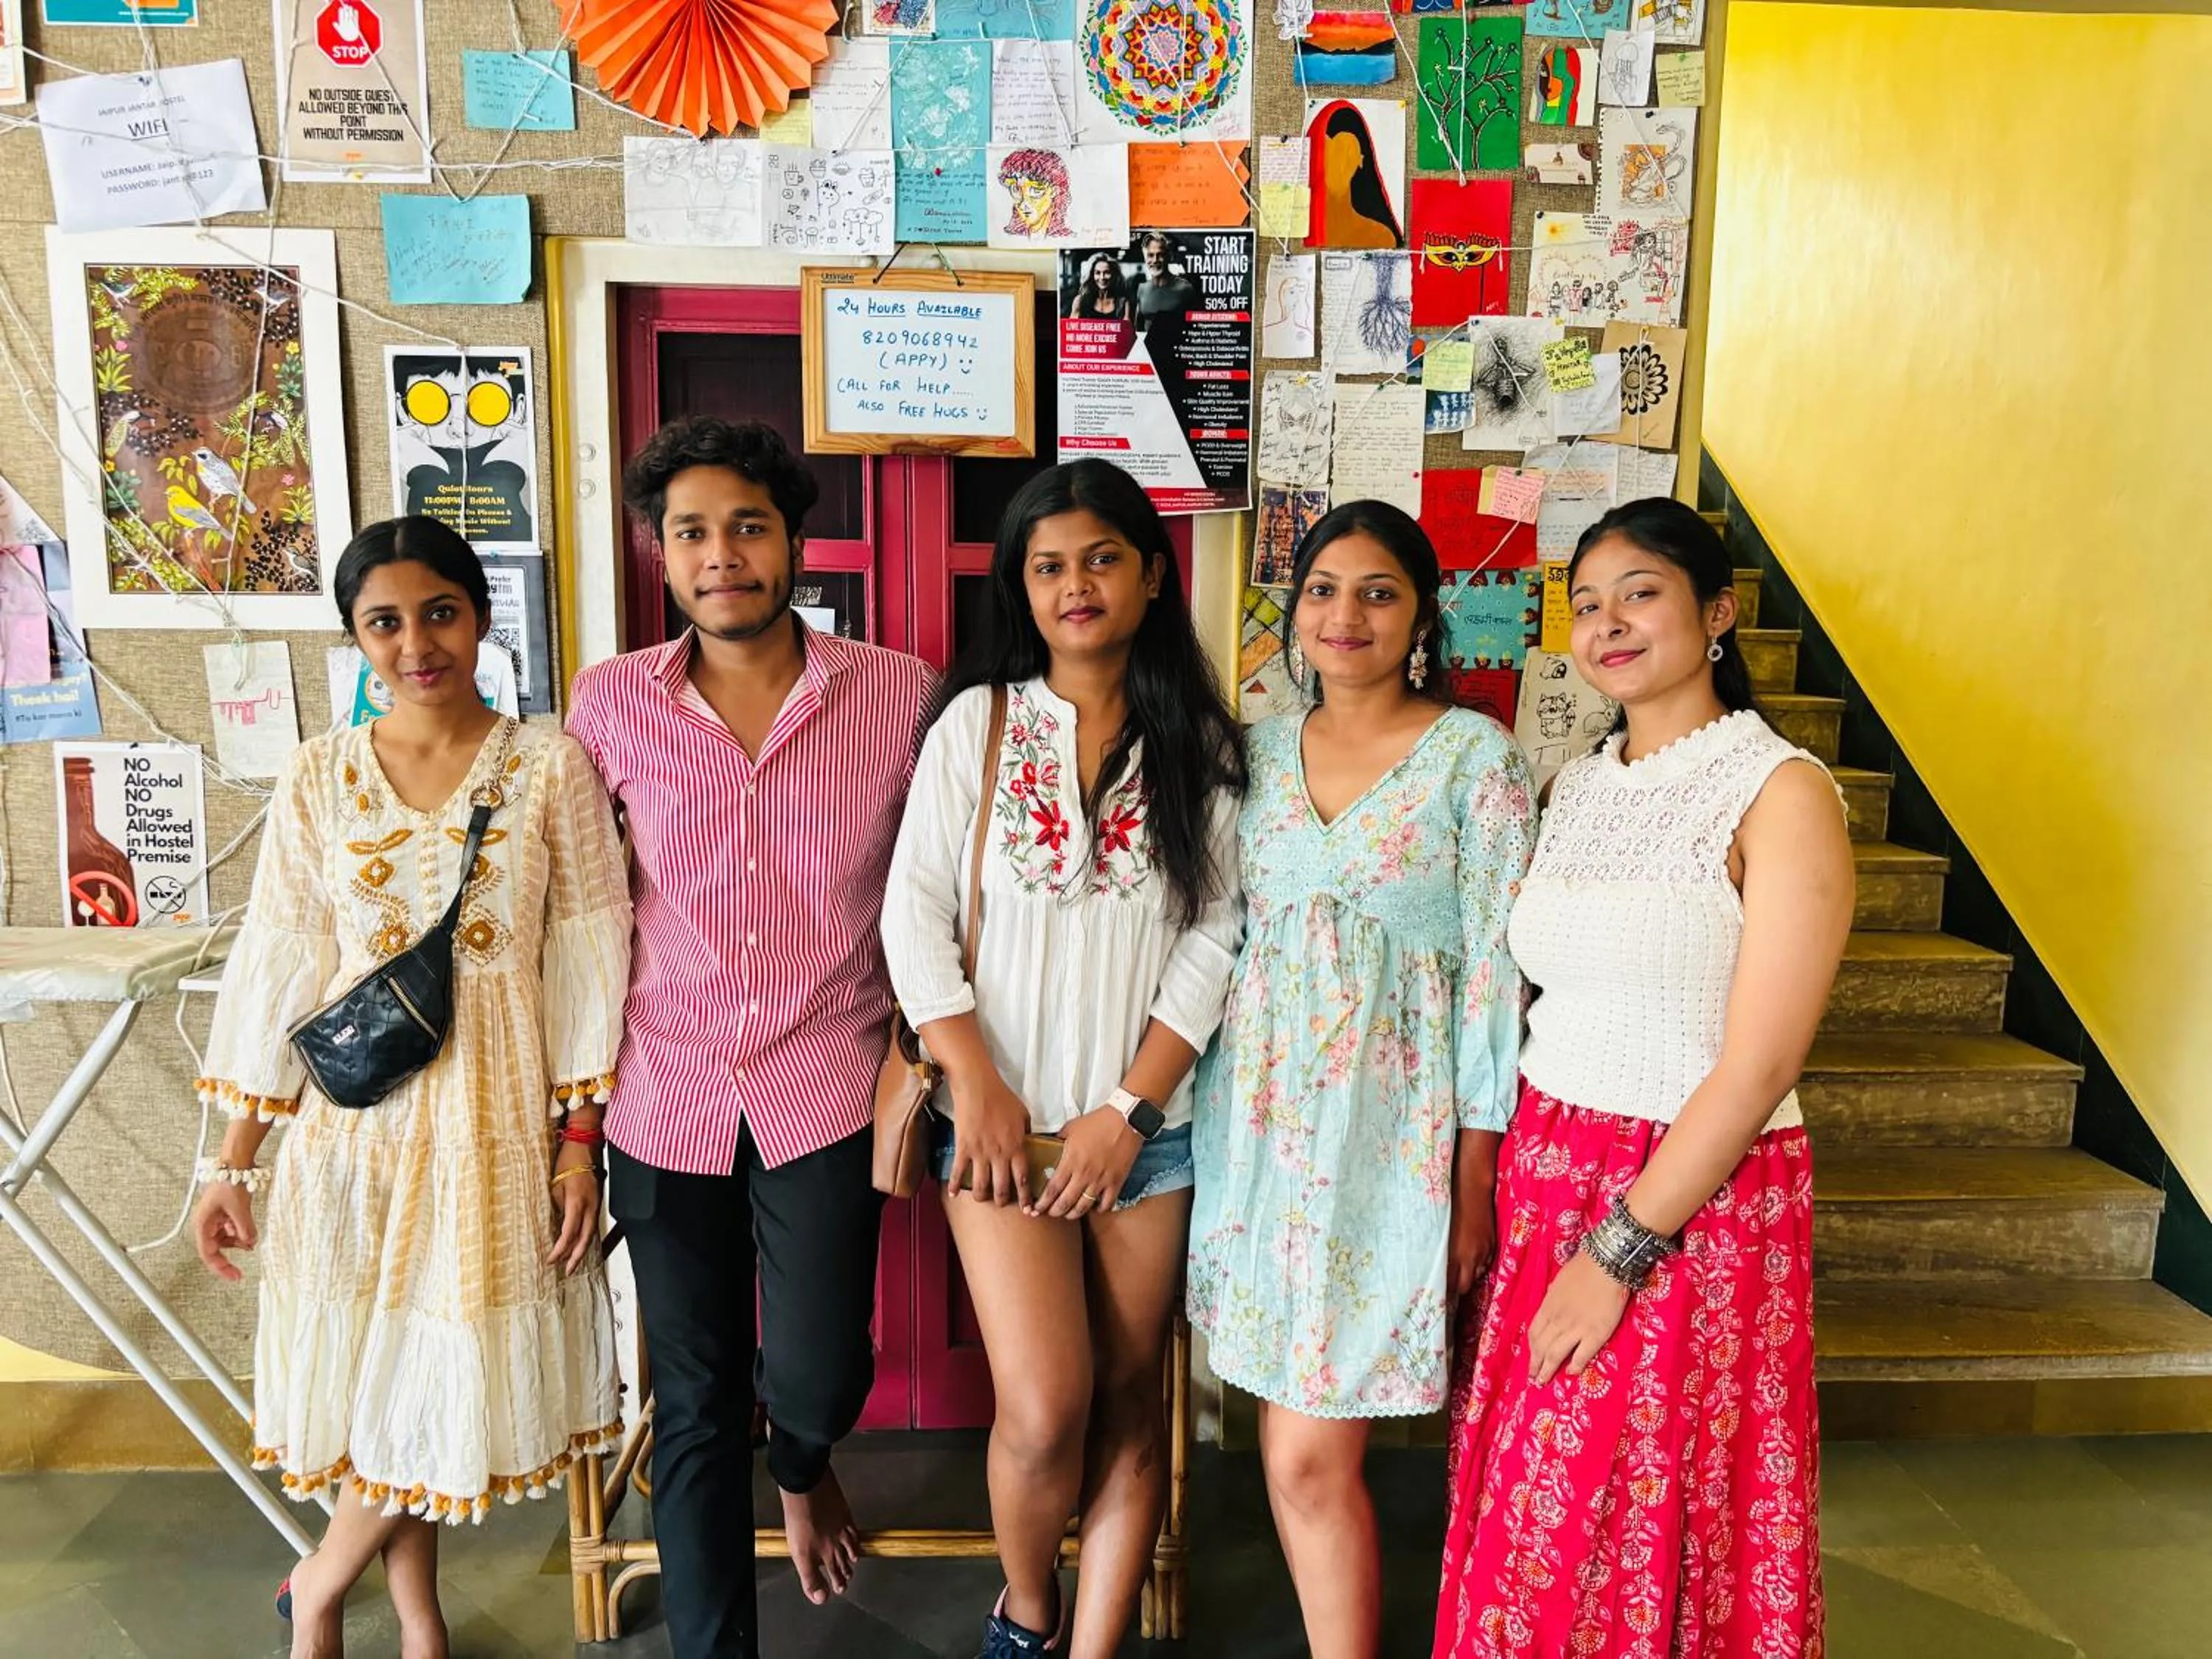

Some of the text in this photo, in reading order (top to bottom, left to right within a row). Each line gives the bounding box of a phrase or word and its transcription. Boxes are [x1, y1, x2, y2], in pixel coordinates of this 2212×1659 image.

[333, 46, 369, 58] STOP
[309, 88, 321, 100] NO
[324, 89, 362, 101] OUTSIDE
[299, 102, 345, 114] ALLOWED
[347, 102, 385, 114] BEYOND
[128, 118, 169, 136] WIFI
[340, 116, 366, 127] POINT
[303, 128, 404, 142] WITHOUT PERMISSION
[107, 178, 159, 194] PASSWORD:
[1204, 236, 1247, 254] START
[1185, 255, 1248, 273] TRAINING
[1200, 276, 1243, 293] TODAY
[837, 298, 982, 317] 24 HOURS AVAILABLE
[1205, 297, 1248, 310] 50% OFF
[1065, 321, 1079, 331] LIVE
[862, 330, 978, 349] 8209068942
[1099, 345, 1107, 353] US
[880, 379, 900, 392] FOR
[857, 399, 968, 418] ALSO FREE HUGS
[1065, 439, 1079, 448] Why
[438, 484, 462, 494] Quiet
[470, 496, 506, 505] 8:00AM
[124, 758, 151, 772] NO
[125, 773, 183, 787] Alcohol
[125, 788, 152, 802] NO
[126, 804, 173, 821] Drugs
[126, 819, 192, 833] Allowed
[127, 834, 194, 848] in Hostel
[128, 849, 191, 863] Premise
